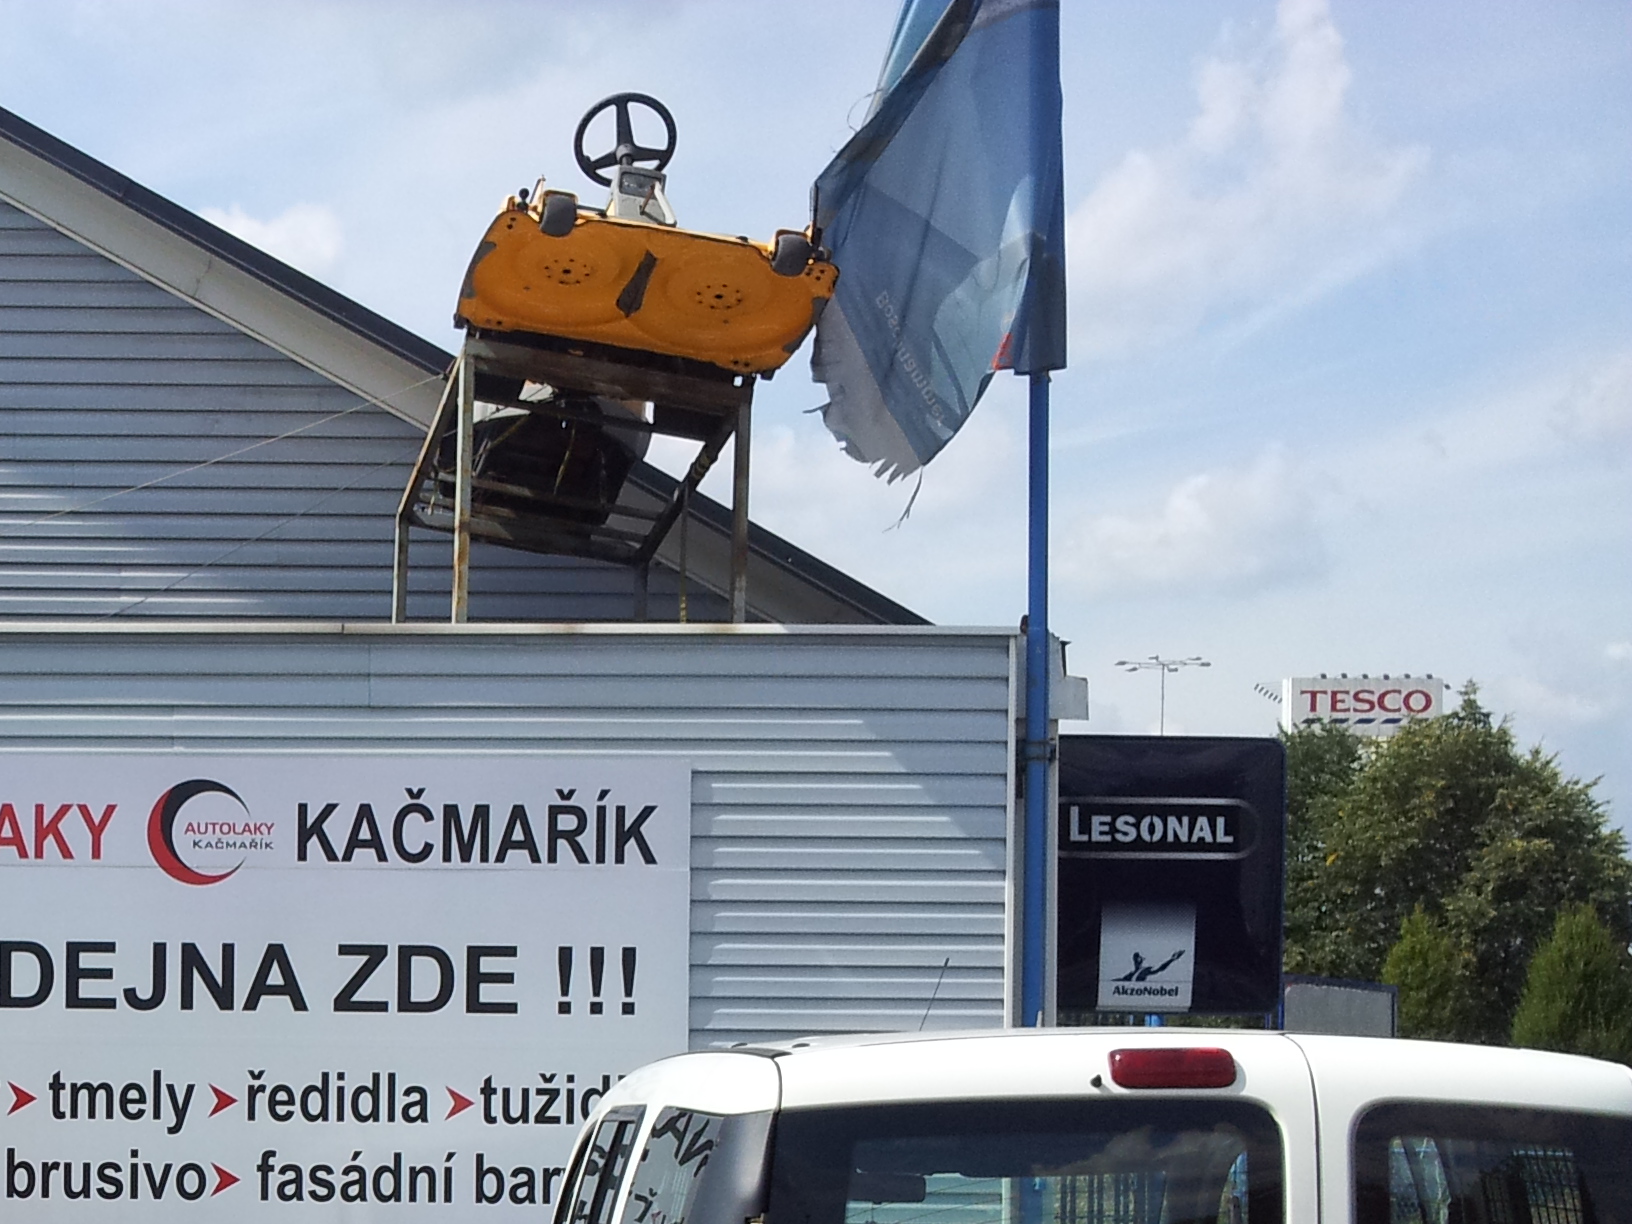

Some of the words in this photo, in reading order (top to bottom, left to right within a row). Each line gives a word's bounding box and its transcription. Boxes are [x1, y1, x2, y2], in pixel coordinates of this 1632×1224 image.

[1300, 688, 1433, 714] TESCO
[184, 821, 275, 836] AUTOLAKY
[297, 787, 658, 865] KAČMAŘÍK
[1069, 805, 1234, 843] LESONAL
[192, 836, 275, 851] KAČMAŘÍK
[332, 943, 519, 1015] ZDE
[557, 945, 637, 1016] !!!
[1112, 985, 1179, 997] AkzoNobel
[48, 1070, 196, 1135] tmely
[246, 1069, 429, 1124] ředidla
[480, 1073, 626, 1125] tužid
[6, 1148, 207, 1201] brusivo
[256, 1150, 457, 1203] fasádní
[475, 1153, 567, 1205] bar
